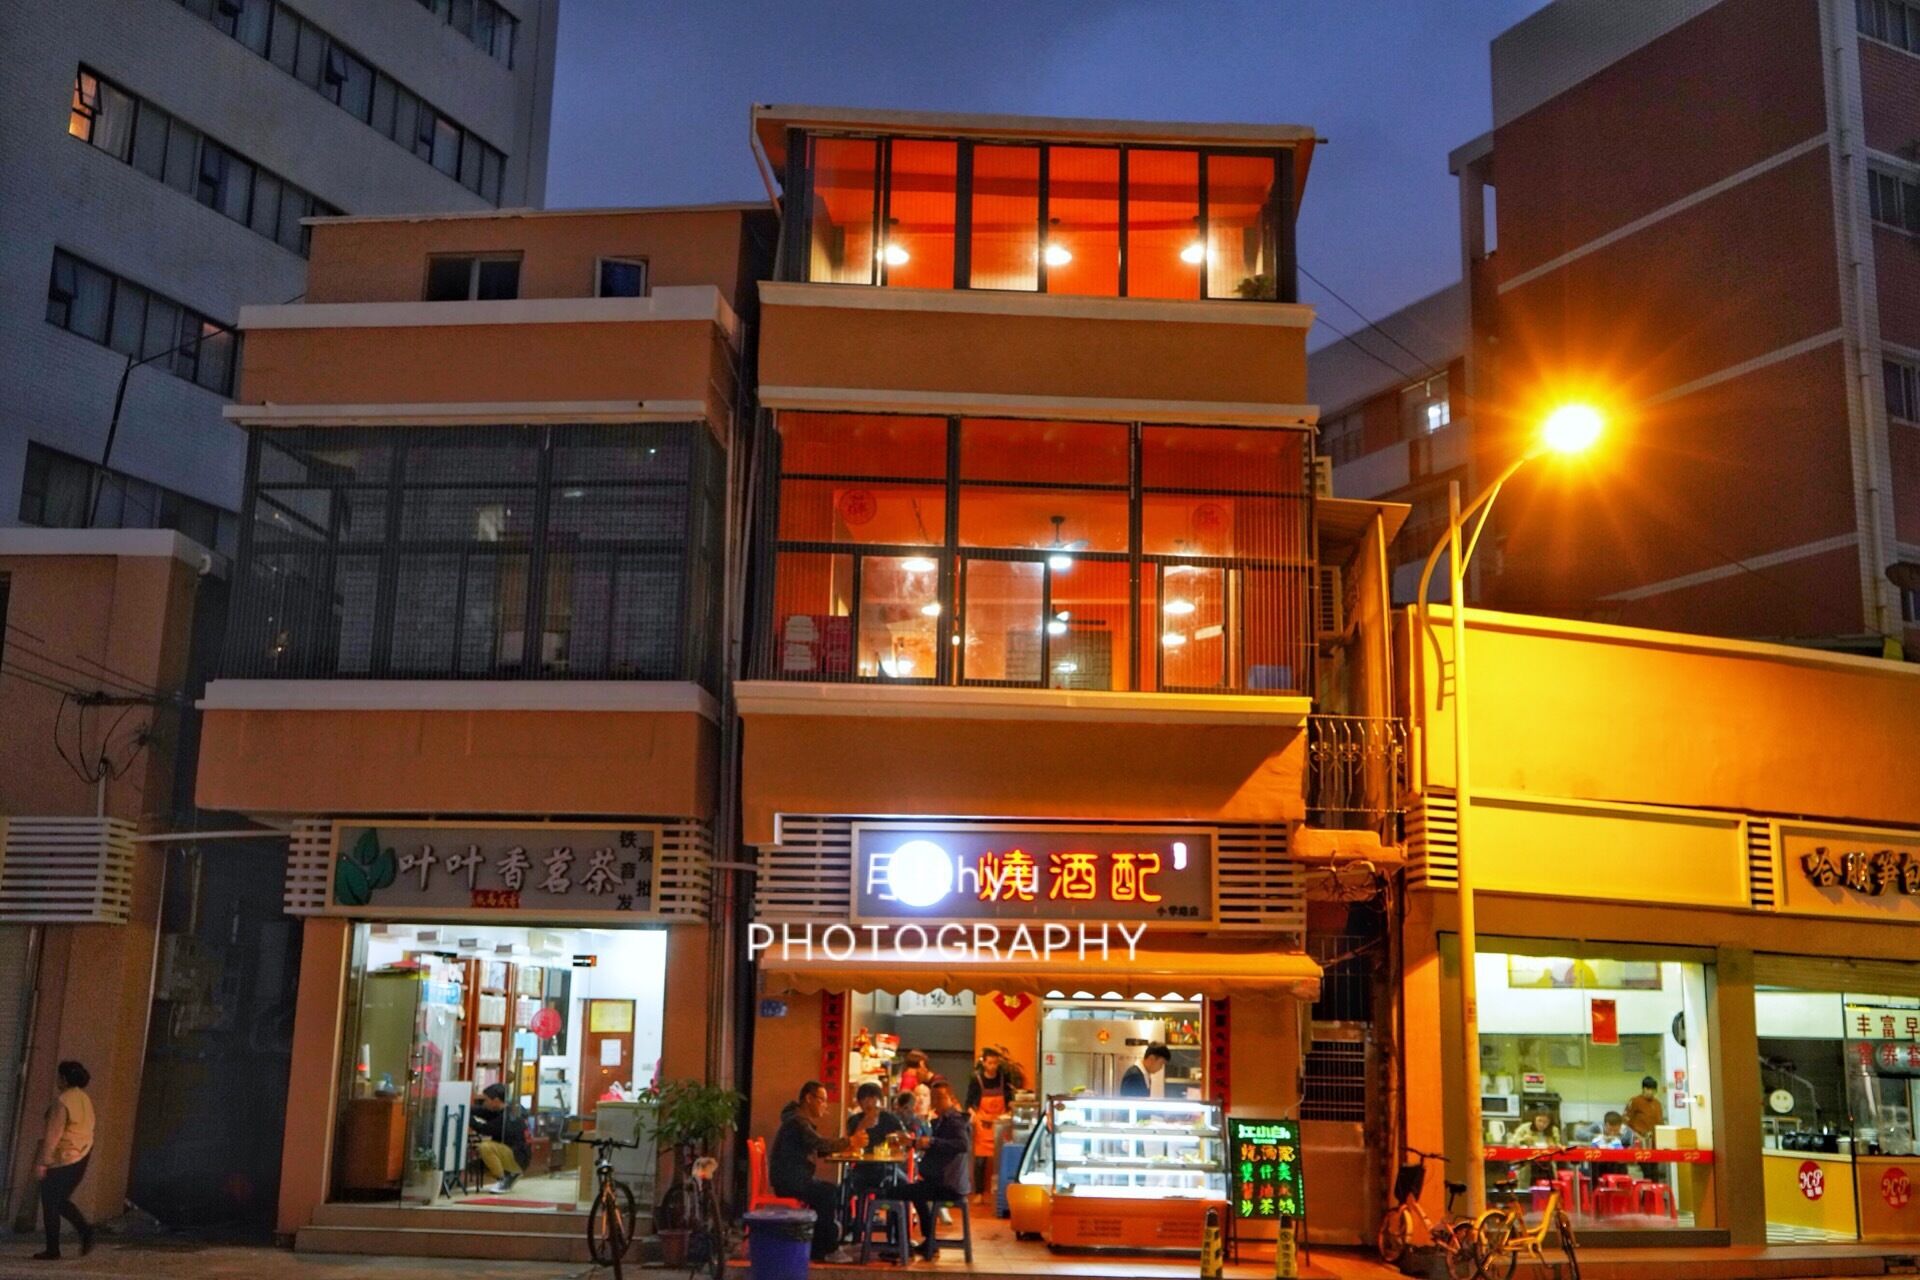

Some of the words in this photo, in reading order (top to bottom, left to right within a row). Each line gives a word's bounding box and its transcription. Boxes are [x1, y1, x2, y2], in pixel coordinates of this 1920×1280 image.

[400, 845, 623, 895] 叶叶香茗茶
[1857, 1014, 1920, 1040] 丰富早
